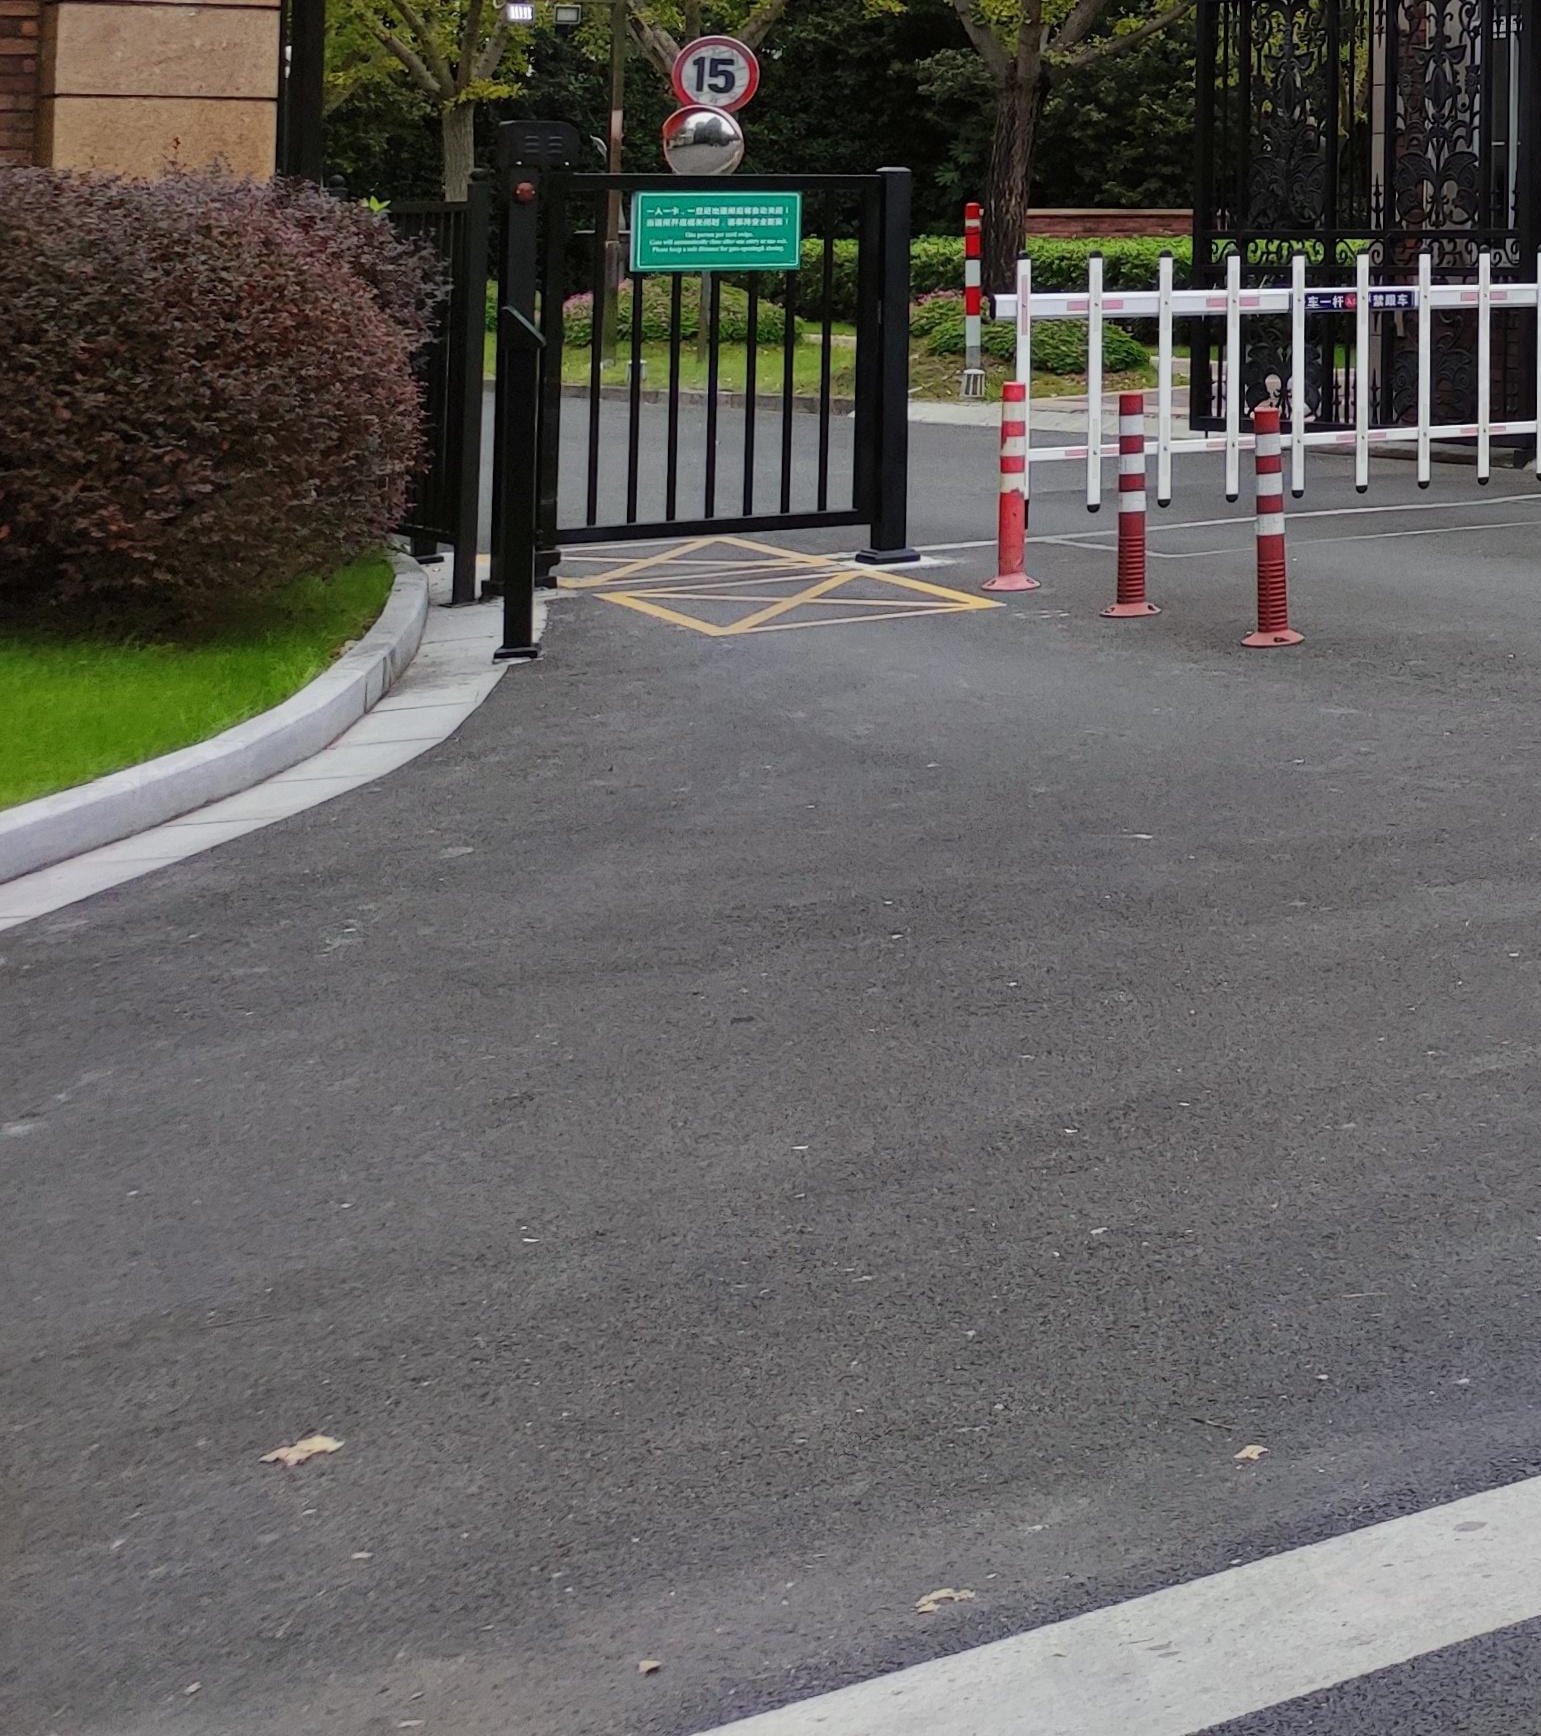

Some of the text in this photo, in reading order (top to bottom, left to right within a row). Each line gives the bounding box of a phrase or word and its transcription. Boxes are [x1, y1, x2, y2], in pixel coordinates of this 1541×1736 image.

[693, 57, 735, 93] 15
[1305, 295, 1344, 308] 车一杆
